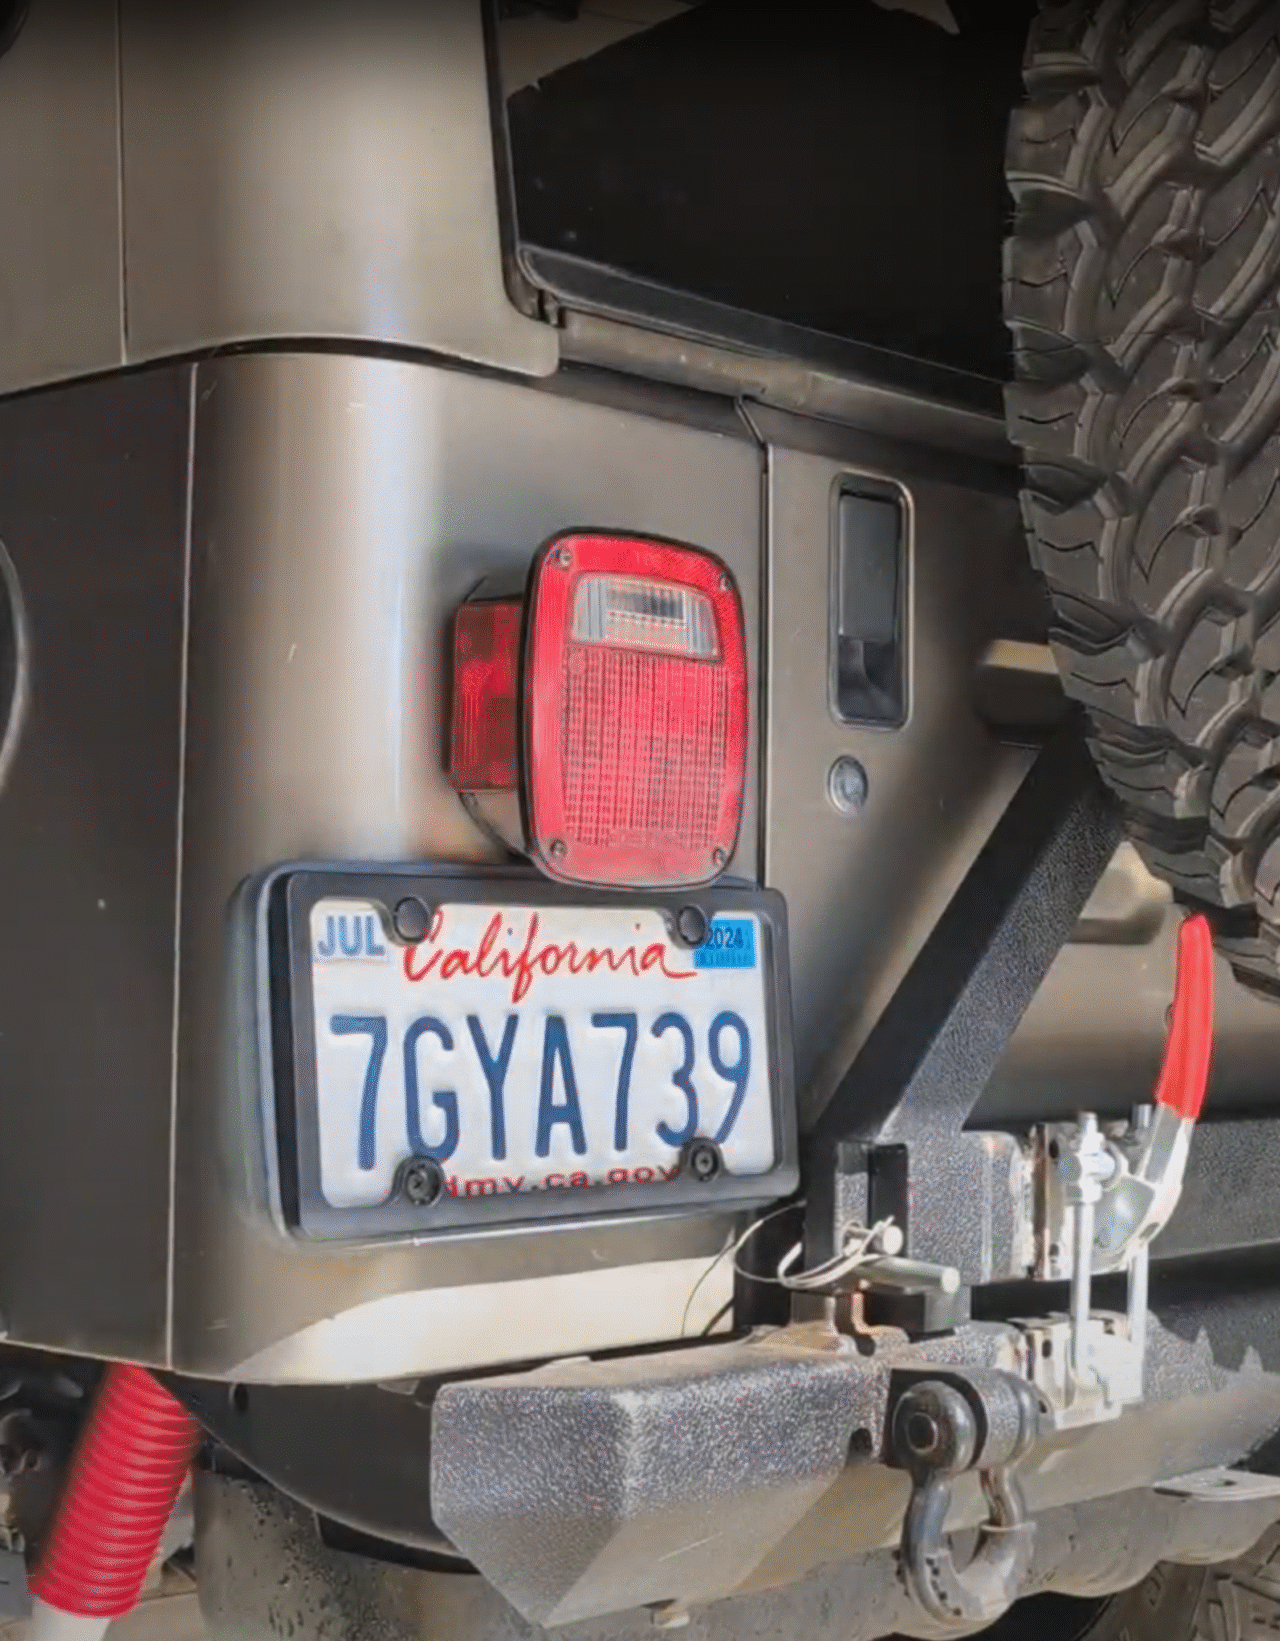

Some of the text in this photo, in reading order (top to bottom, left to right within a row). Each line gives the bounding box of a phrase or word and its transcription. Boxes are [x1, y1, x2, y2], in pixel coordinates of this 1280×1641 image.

[318, 915, 386, 957] JUL
[402, 911, 698, 1004] California
[329, 1010, 752, 1171] 7GYA739
